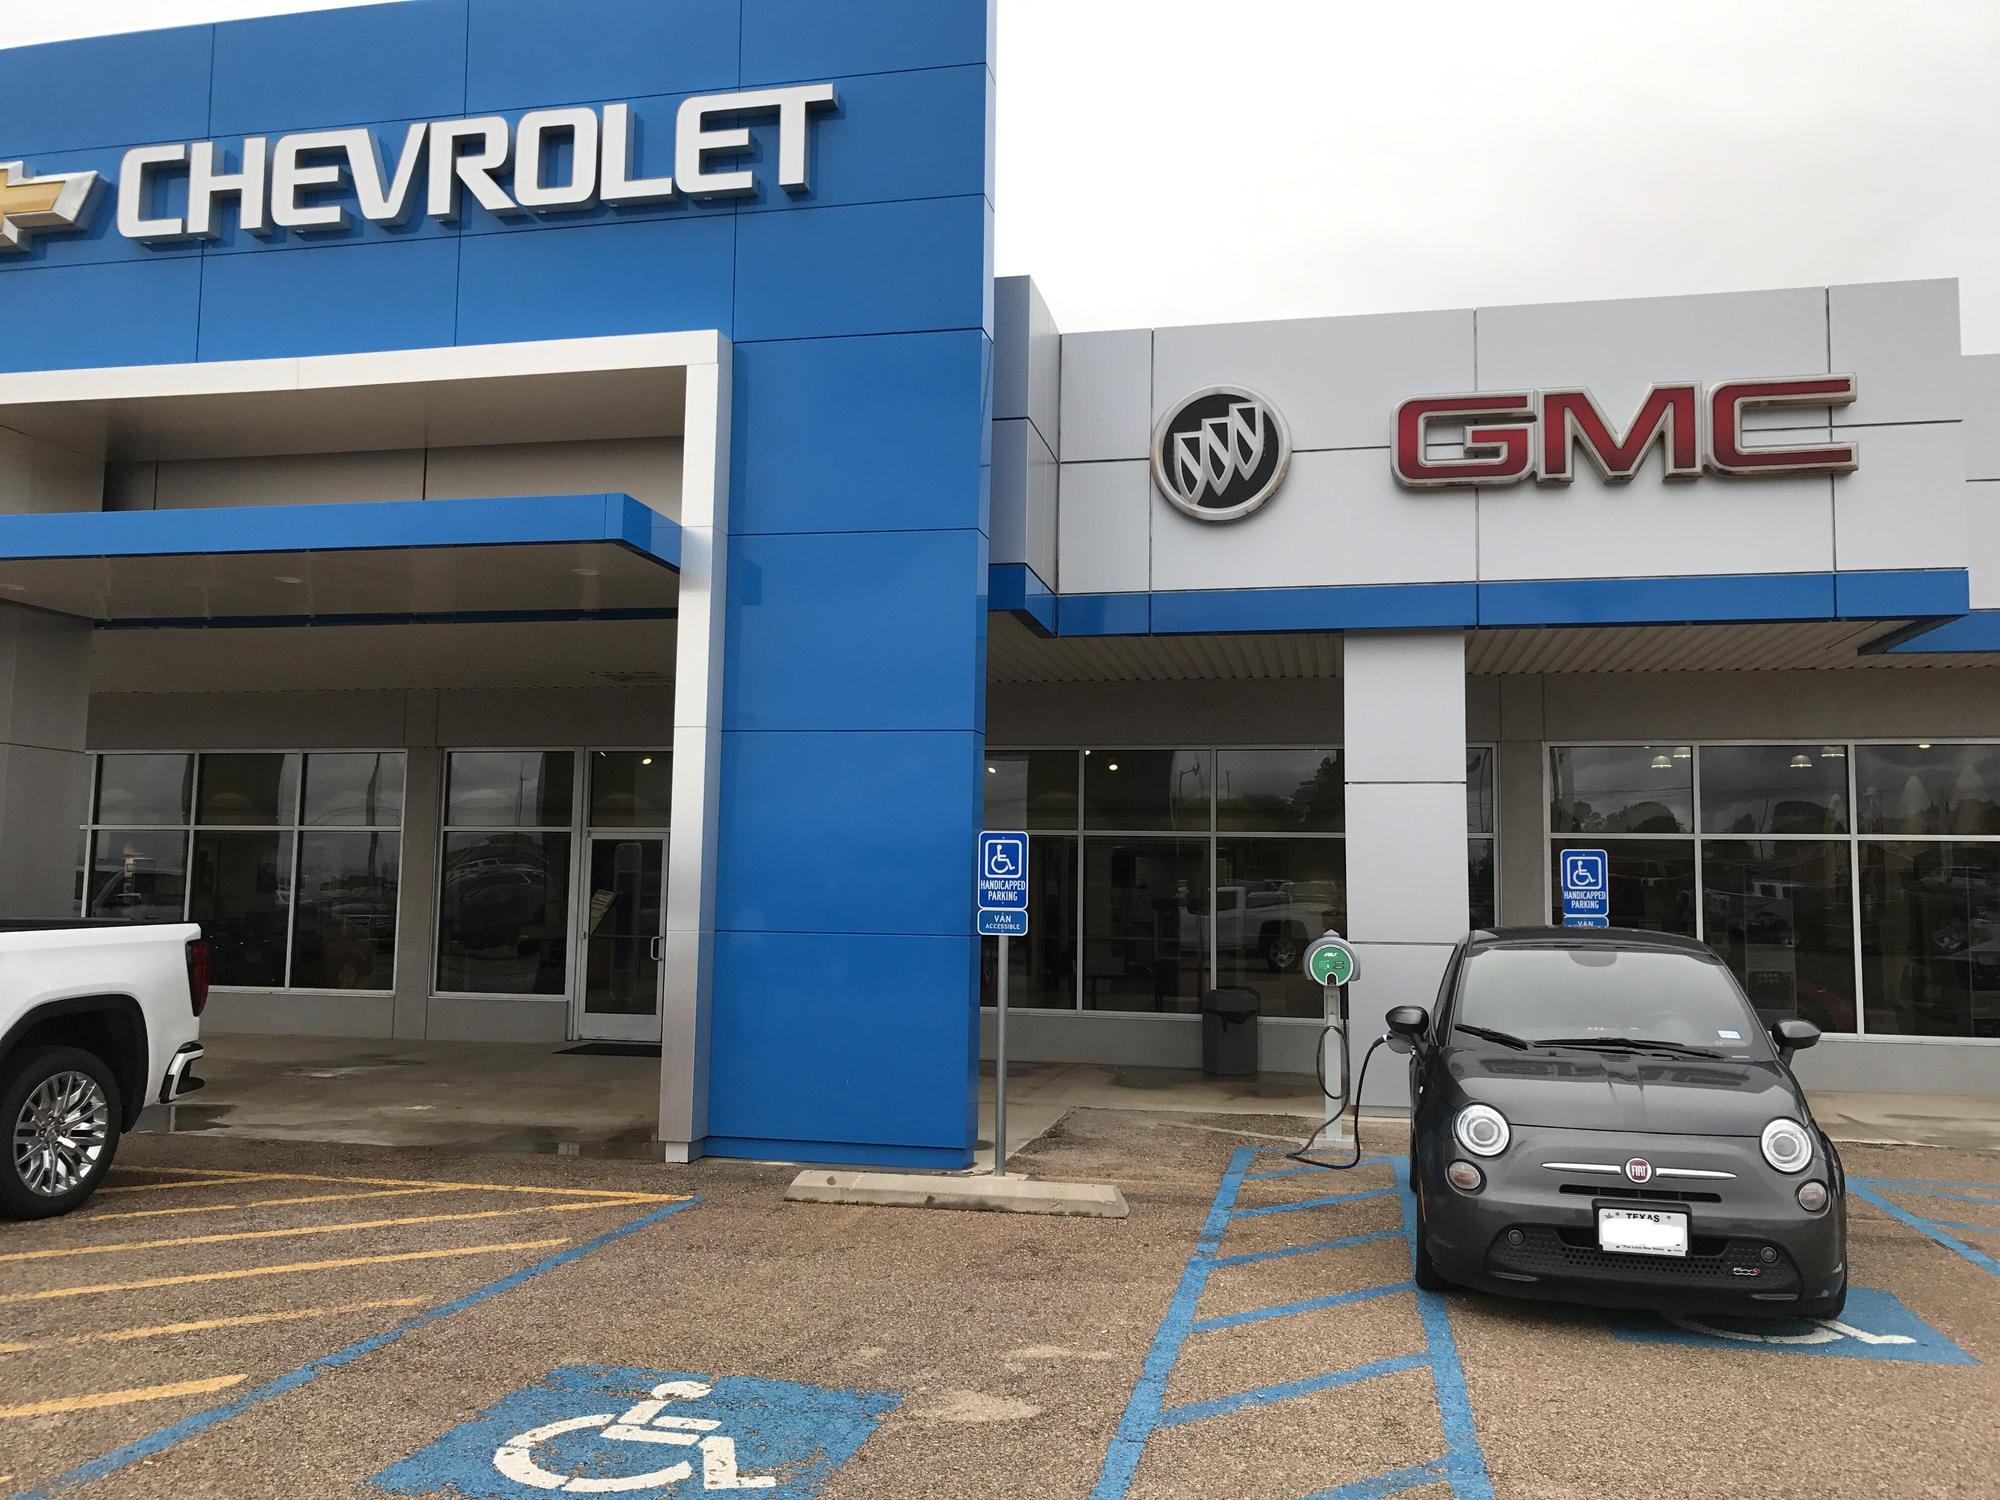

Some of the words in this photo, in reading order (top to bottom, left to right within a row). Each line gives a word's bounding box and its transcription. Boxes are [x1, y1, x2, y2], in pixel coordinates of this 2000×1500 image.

[117, 83, 838, 243] CHEVROLET
[1390, 372, 1859, 488] GMC
[980, 880, 1026, 890] HANDICAPPED
[988, 891, 1018, 901] PARKING
[1563, 890, 1606, 900] HANDICAPPED
[1571, 900, 1600, 909] PARKING
[1631, 1165, 1647, 1177] FIAT
[1626, 1213, 1660, 1223] TEXAS
